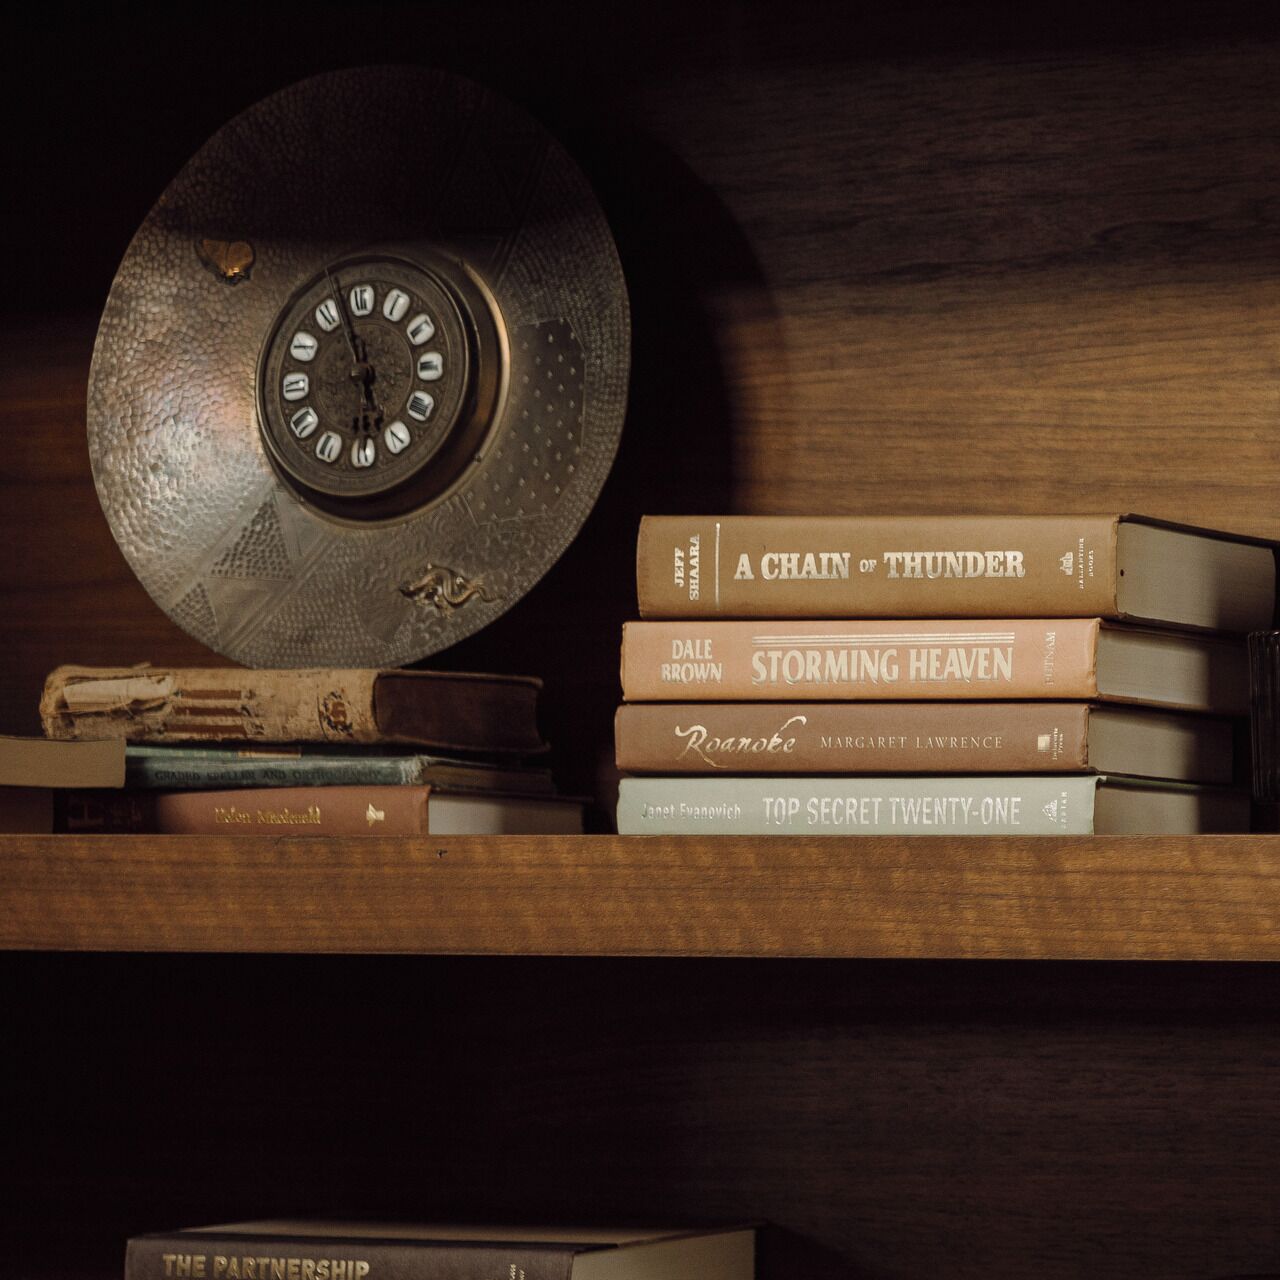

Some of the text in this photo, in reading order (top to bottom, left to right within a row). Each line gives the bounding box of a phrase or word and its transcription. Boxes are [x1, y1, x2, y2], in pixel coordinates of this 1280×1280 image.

[674, 547, 685, 588] JEFF
[689, 534, 700, 600] SHAARA
[734, 551, 1027, 581] A CHAIN OF THUNDER
[671, 639, 713, 660] DALE
[661, 662, 724, 684] BROWN
[751, 646, 1014, 686] STORMING HEAVEN
[675, 715, 1004, 768] Roanoke MARGARET LAWRENCE
[641, 803, 742, 822] Janet Evanovich
[762, 796, 1022, 826] TOP SECRET TWENTY-ONE
[163, 1253, 207, 1279] THE
